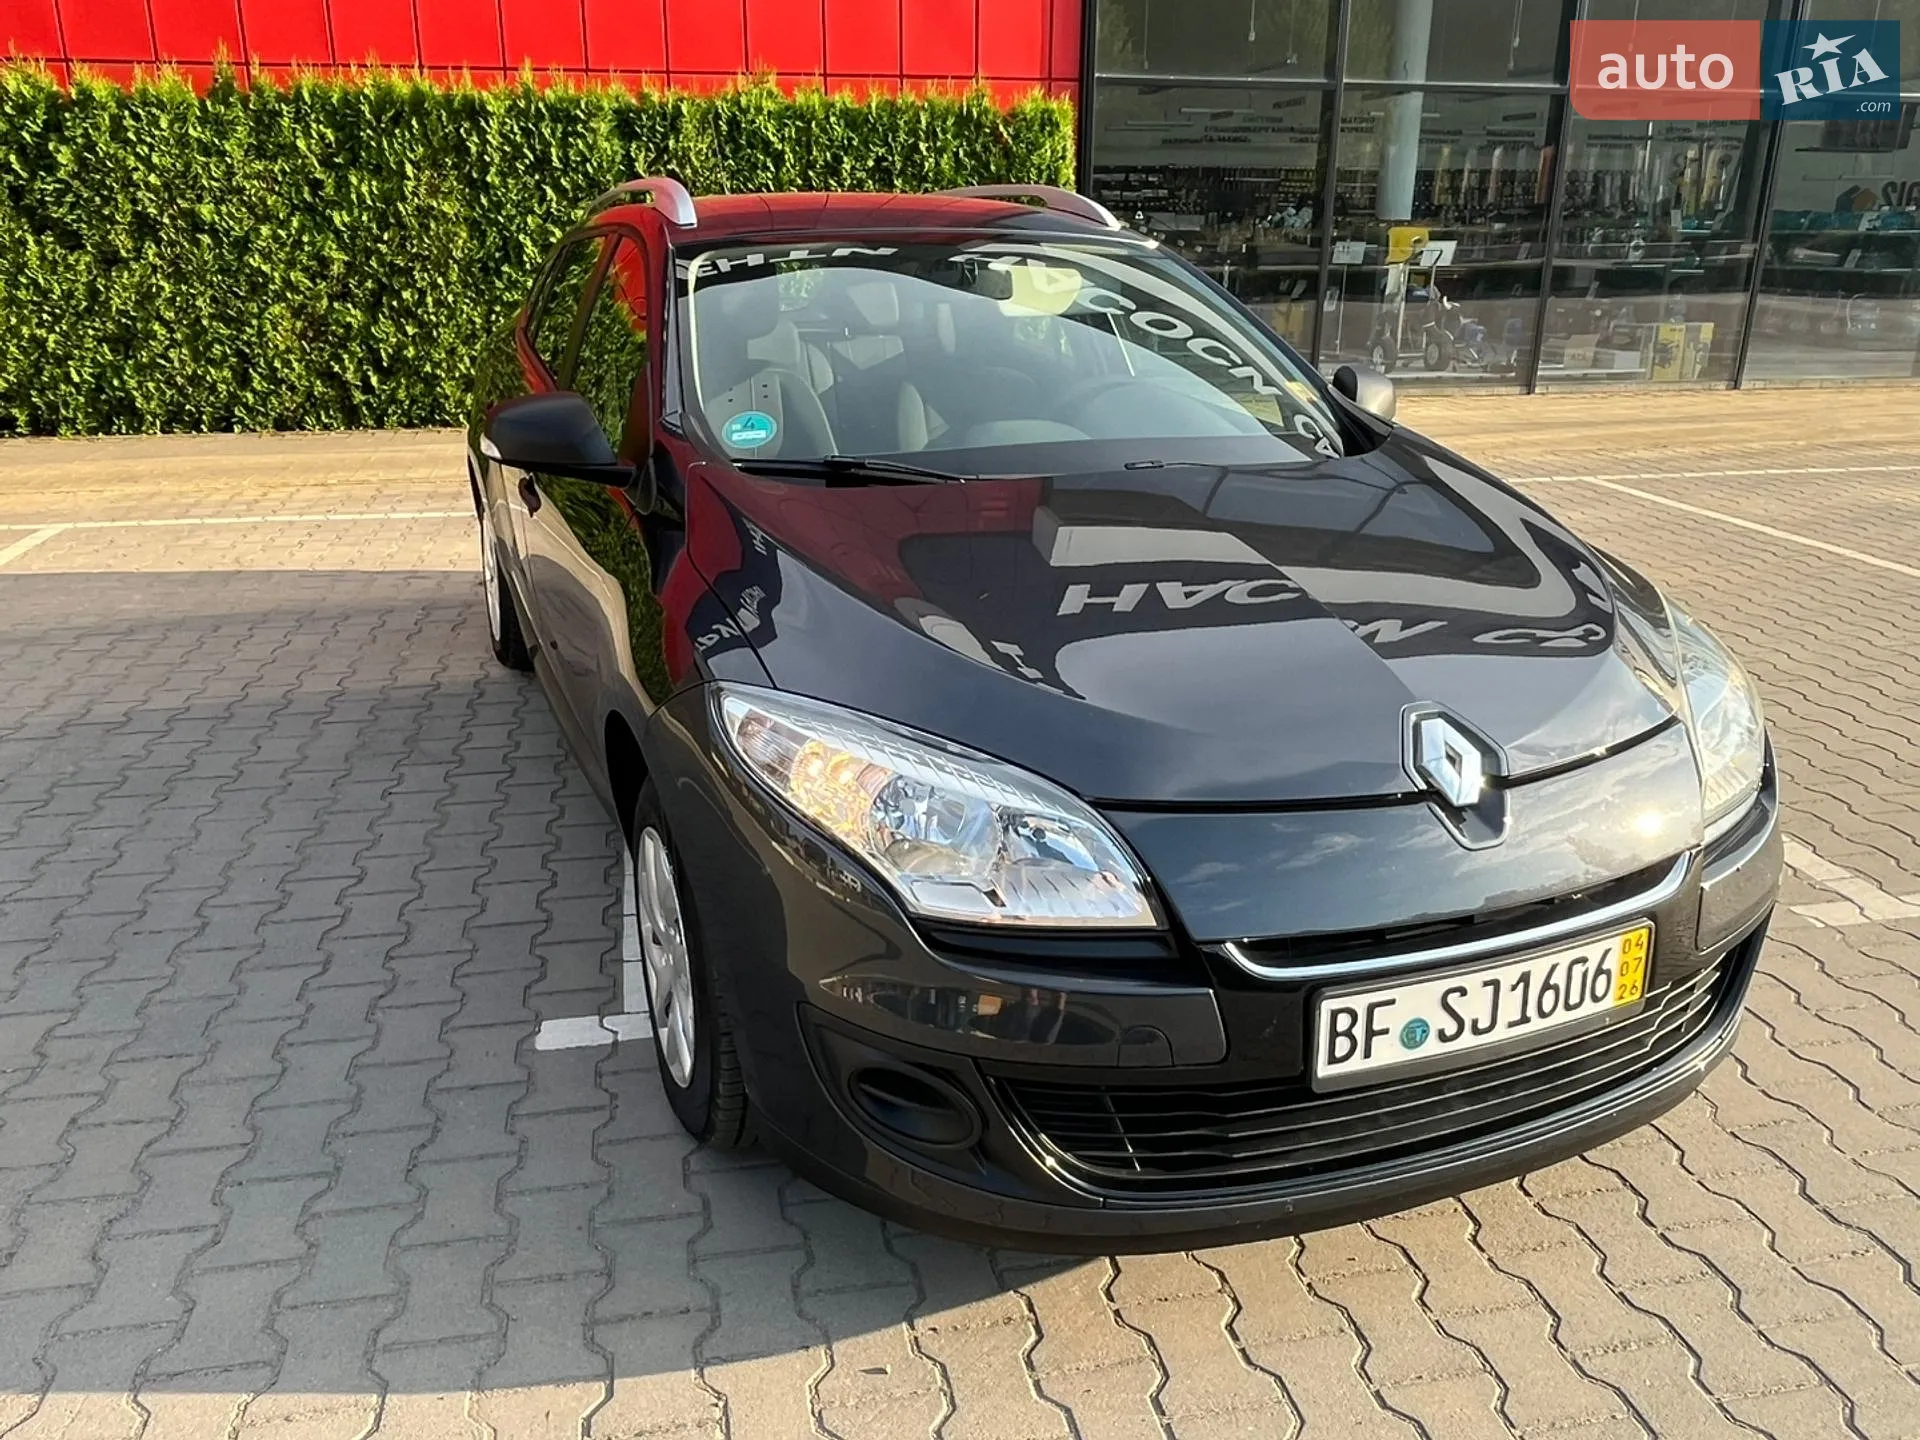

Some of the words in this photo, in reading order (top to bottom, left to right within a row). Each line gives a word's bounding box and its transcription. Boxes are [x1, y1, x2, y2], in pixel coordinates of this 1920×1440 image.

[1622, 932, 1644, 955] 04
[1620, 956, 1643, 977] 07
[1617, 980, 1639, 1001] 26
[1326, 997, 1397, 1065] BF
[1437, 947, 1613, 1044] SJ1606
